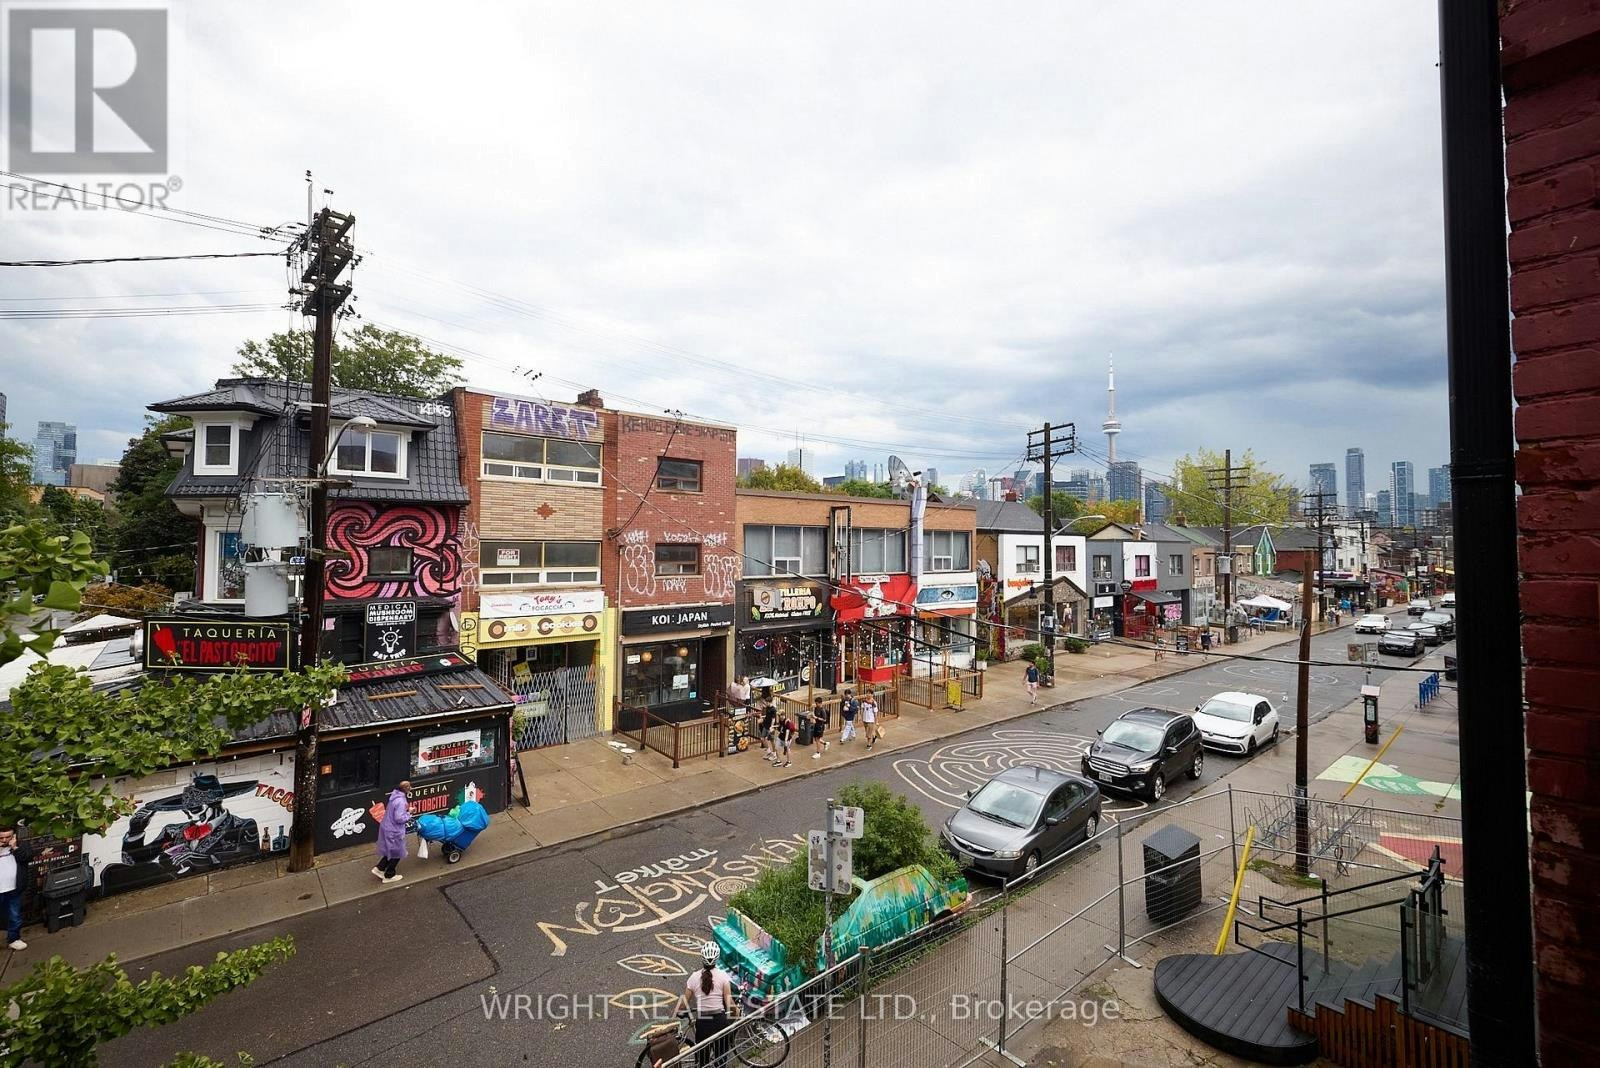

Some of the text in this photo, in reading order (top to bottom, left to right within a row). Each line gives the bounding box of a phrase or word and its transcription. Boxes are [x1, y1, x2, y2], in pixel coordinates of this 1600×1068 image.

[677, 612, 708, 624] JAPAN
[183, 626, 276, 639] TAQUERÍA
[372, 648, 406, 660] DAY TRIP
[407, 784, 448, 799] QUERÍA
